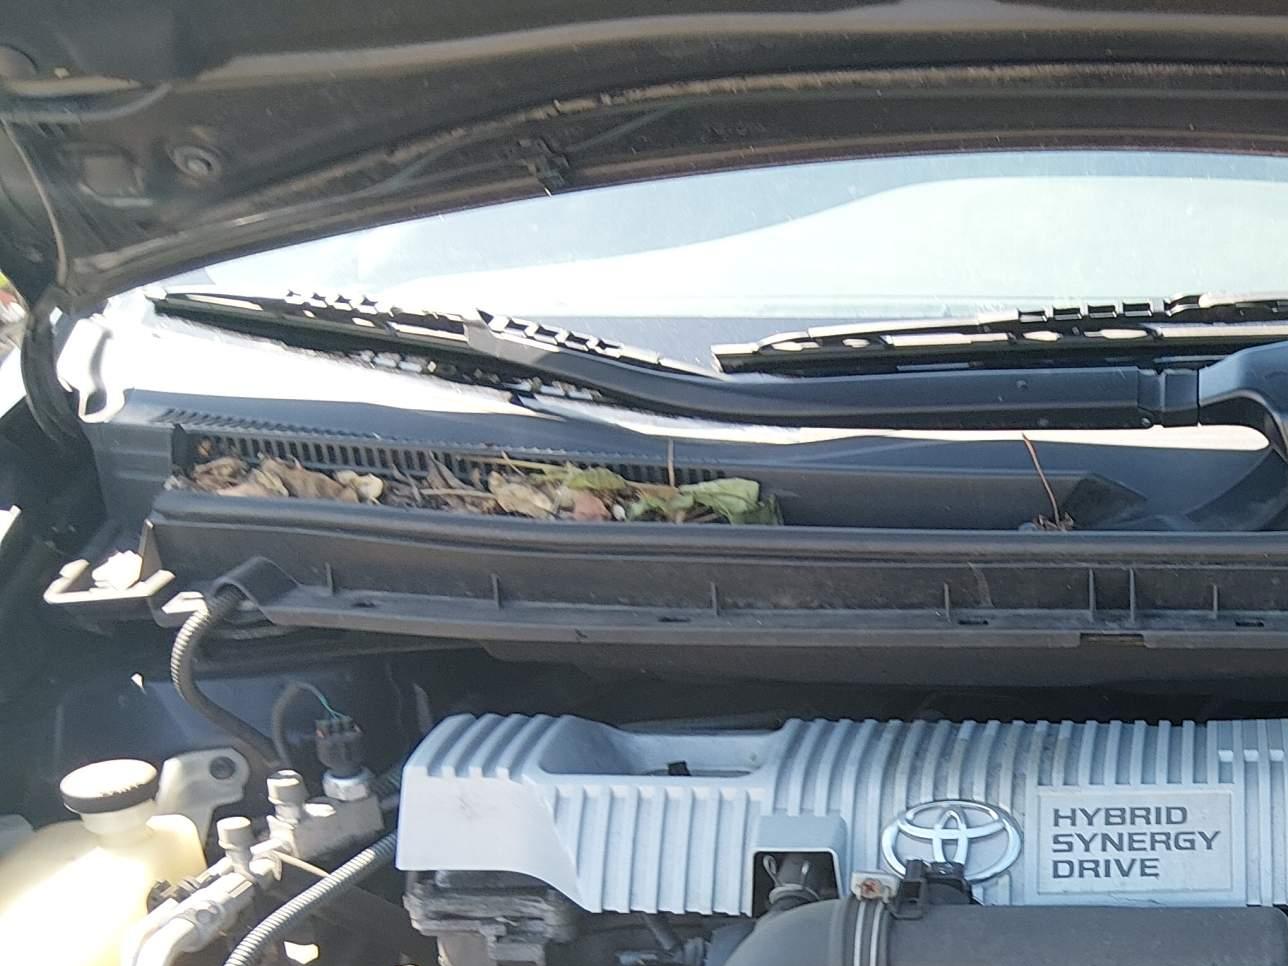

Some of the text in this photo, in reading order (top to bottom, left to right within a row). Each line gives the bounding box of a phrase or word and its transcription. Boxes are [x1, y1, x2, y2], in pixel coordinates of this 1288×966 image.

[1053, 806, 1188, 828] HYBRID
[1052, 830, 1222, 853] SYNERGY
[1053, 858, 1161, 879] DRIVE
